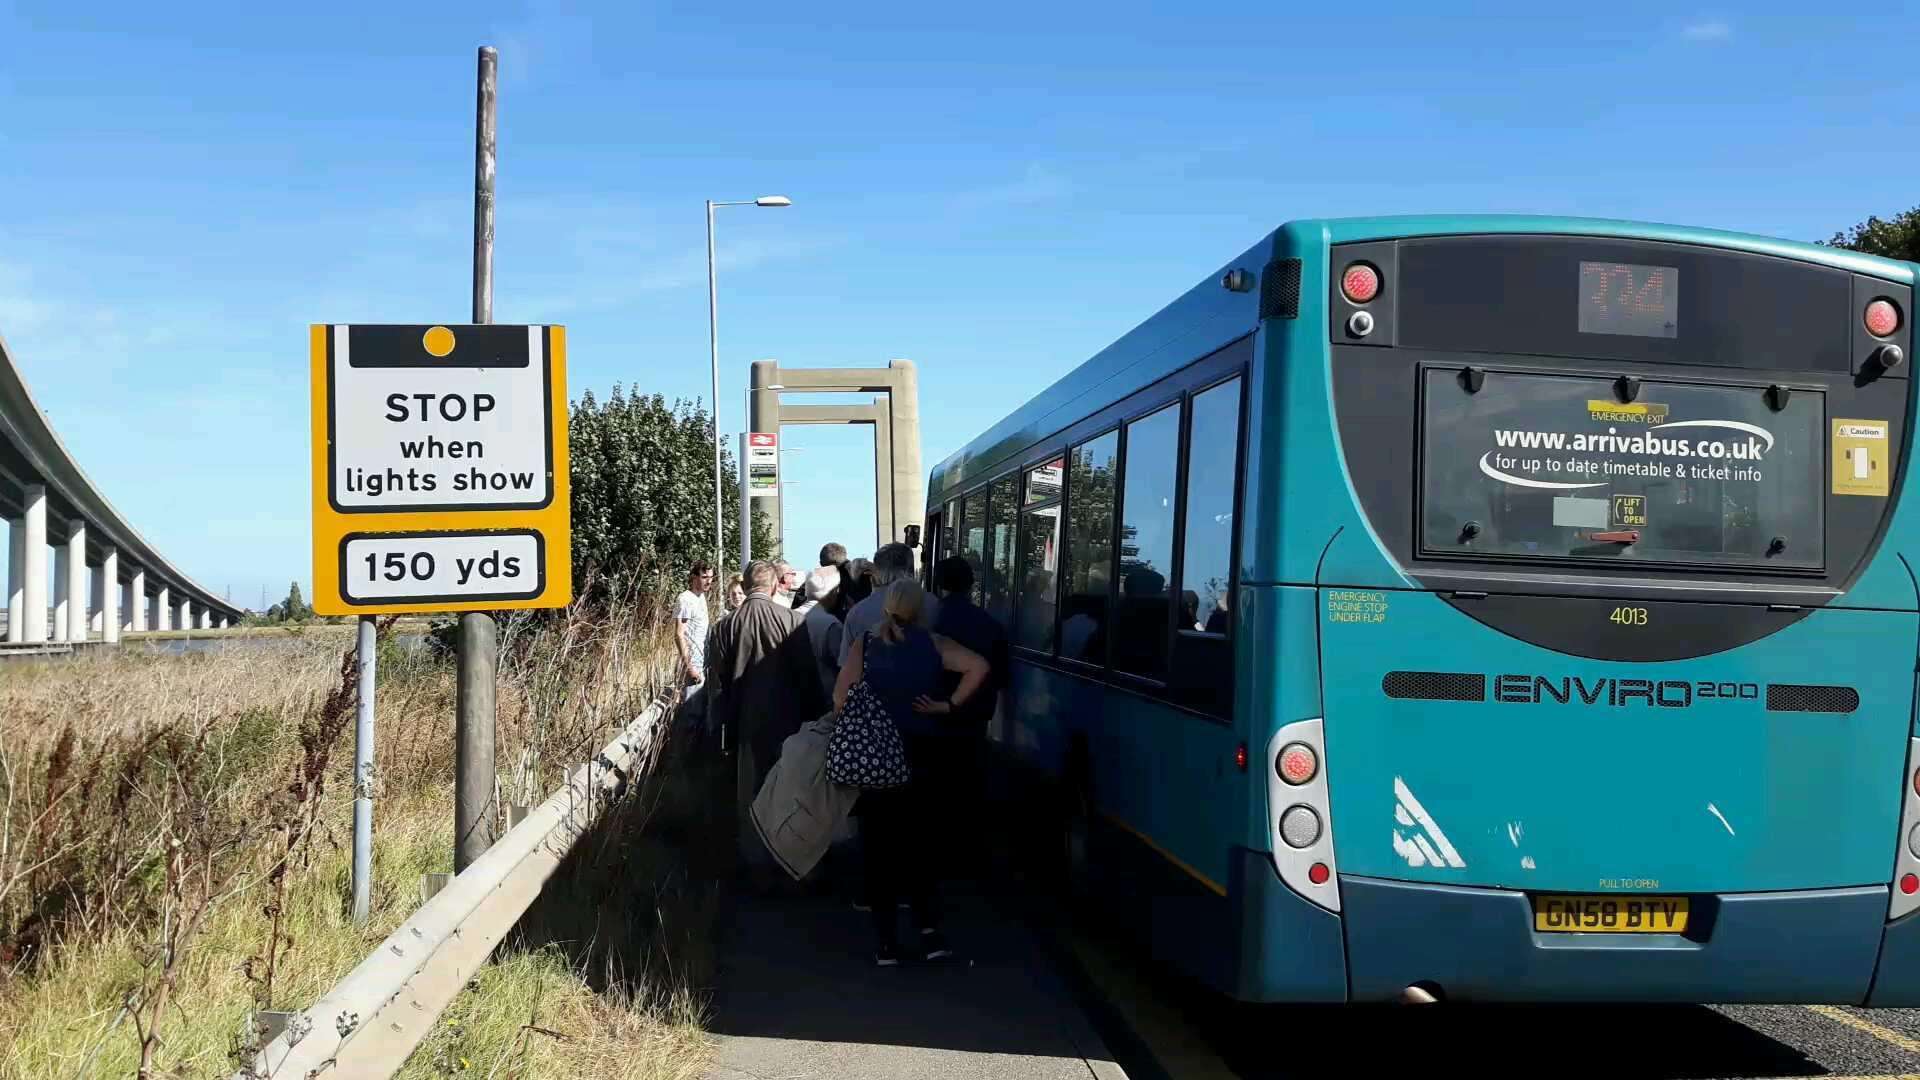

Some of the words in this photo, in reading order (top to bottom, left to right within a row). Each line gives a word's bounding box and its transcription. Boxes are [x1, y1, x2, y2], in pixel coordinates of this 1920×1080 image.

[385, 393, 496, 422] STOP
[1591, 411, 1645, 423] EMERGENCY
[1647, 414, 1665, 424] EXIT
[1850, 427, 1880, 436] Caution
[400, 436, 484, 459] when
[1494, 427, 1763, 460] www.arrivabus.co.uk
[1496, 453, 1517, 469] for
[1522, 458, 1541, 473] up
[1547, 458, 1561, 472] to
[1566, 458, 1599, 474] date
[1603, 459, 1671, 478] timetable
[1675, 463, 1686, 478] &
[1691, 464, 1730, 480] ticket
[1734, 465, 1762, 482] info
[346, 468, 437, 497] lights
[452, 467, 534, 491] show
[1623, 498, 1641, 507] LIFT
[1623, 506, 1634, 515] TO
[1623, 515, 1646, 524] OPEN
[364, 551, 435, 582] 150
[456, 549, 521, 585] yds
[1328, 591, 1386, 602] EMERGENCY
[1328, 602, 1362, 612] ENGINE
[1364, 602, 1388, 613] STOP
[1329, 612, 1361, 622] UNDER
[1363, 612, 1385, 623] FLAP
[1609, 607, 1648, 625] 4013
[1494, 674, 1692, 707] ENVIRO
[1696, 682, 1758, 699] 200
[1599, 878, 1618, 889] PULL
[1621, 878, 1634, 889] TO
[1635, 879, 1659, 889] OPEN
[1546, 901, 1617, 927] GN58
[1625, 902, 1677, 928] BTV
